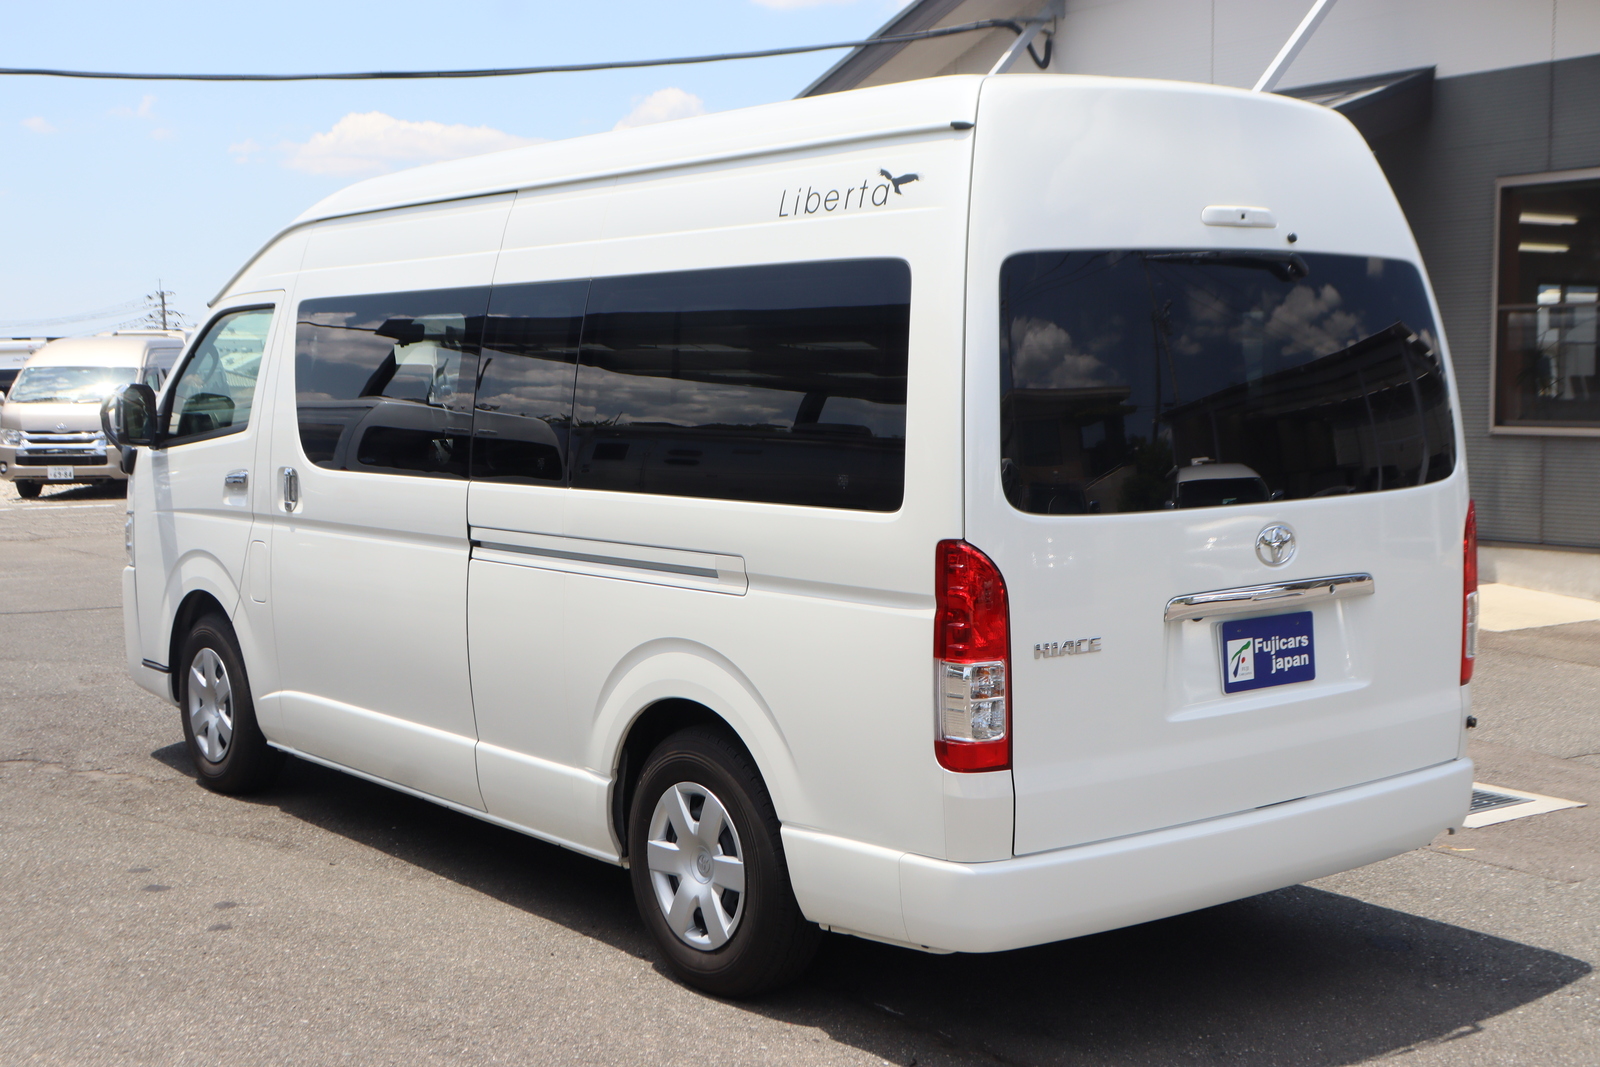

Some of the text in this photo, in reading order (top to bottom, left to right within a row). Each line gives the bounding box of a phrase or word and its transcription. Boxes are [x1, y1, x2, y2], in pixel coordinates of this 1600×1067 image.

[778, 179, 890, 217] Liberta
[1034, 637, 1101, 659] HIACE
[1254, 635, 1309, 655] Fujicars
[1271, 653, 1309, 674] japan
